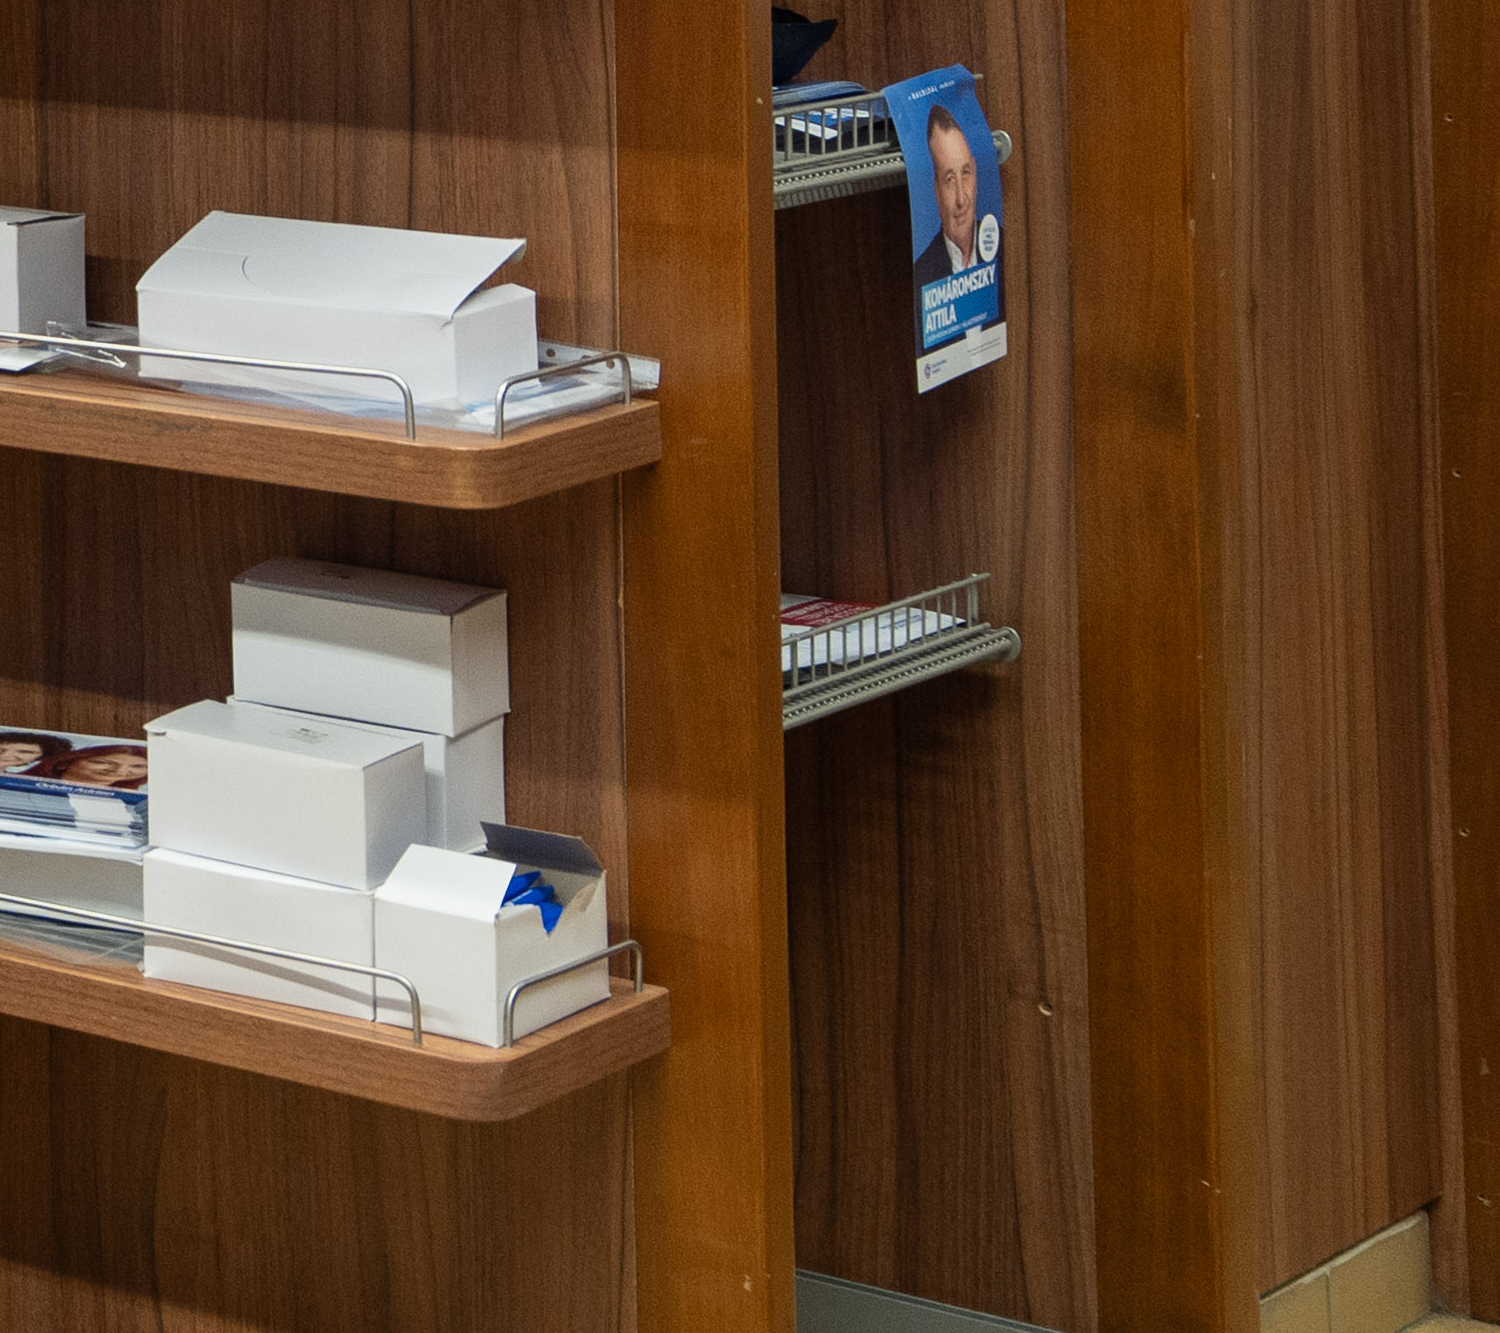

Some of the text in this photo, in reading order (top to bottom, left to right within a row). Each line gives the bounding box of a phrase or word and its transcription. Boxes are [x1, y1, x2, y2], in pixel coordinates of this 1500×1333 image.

[924, 264, 996, 311] KOMÁROMSZKY
[926, 304, 957, 334] ATTILA
[35, 781, 72, 793] Orbán
